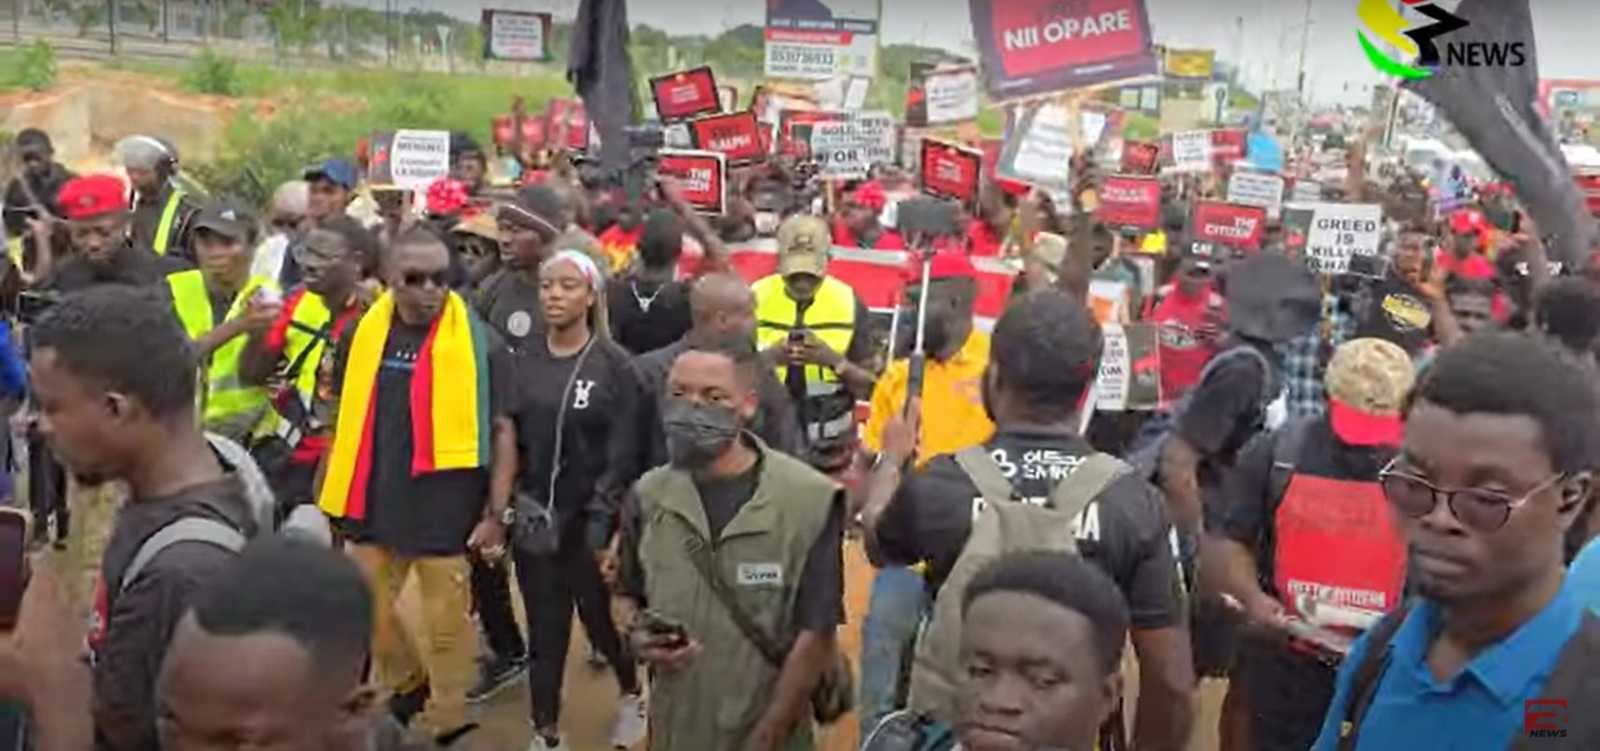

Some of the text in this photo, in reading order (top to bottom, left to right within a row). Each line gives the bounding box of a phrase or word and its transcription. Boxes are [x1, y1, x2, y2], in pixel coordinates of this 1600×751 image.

[1003, 9, 1132, 50] NII OPARE
[1317, 218, 1377, 232] GREED
[1336, 233, 1355, 245] IS
